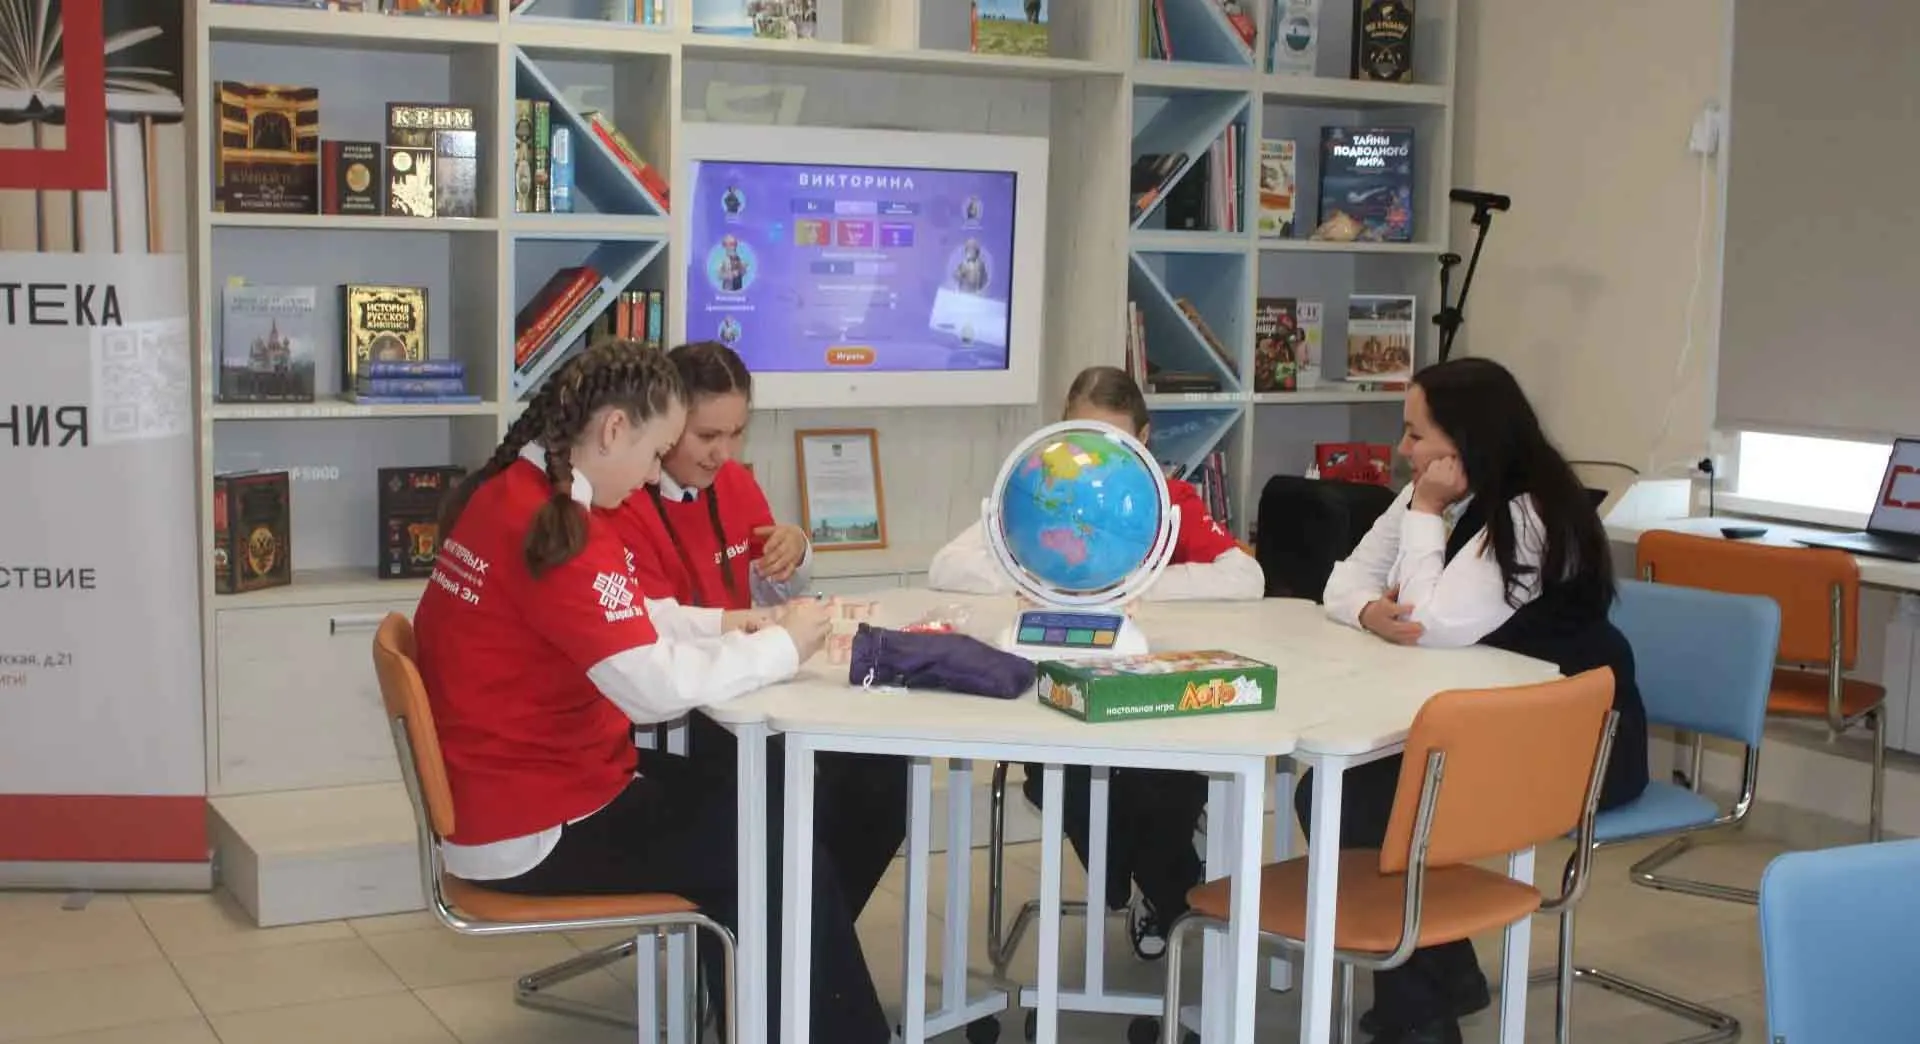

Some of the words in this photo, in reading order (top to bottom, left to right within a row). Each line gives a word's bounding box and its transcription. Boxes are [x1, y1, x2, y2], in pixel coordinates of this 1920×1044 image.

[395, 110, 470, 127] КРЫМ
[1352, 134, 1390, 145] ТАЙНЫ
[1333, 146, 1409, 157] ПОДВОДНОГО
[1355, 156, 1386, 167] МИРА
[799, 172, 915, 190] ВИКТОРИНА
[0, 283, 122, 327] ТЕКА
[366, 303, 409, 313] ИСТОРИЯ
[366, 312, 409, 322] РУССКОЙ
[1106, 705, 1153, 716] настольная
[1155, 703, 1175, 715] игра
